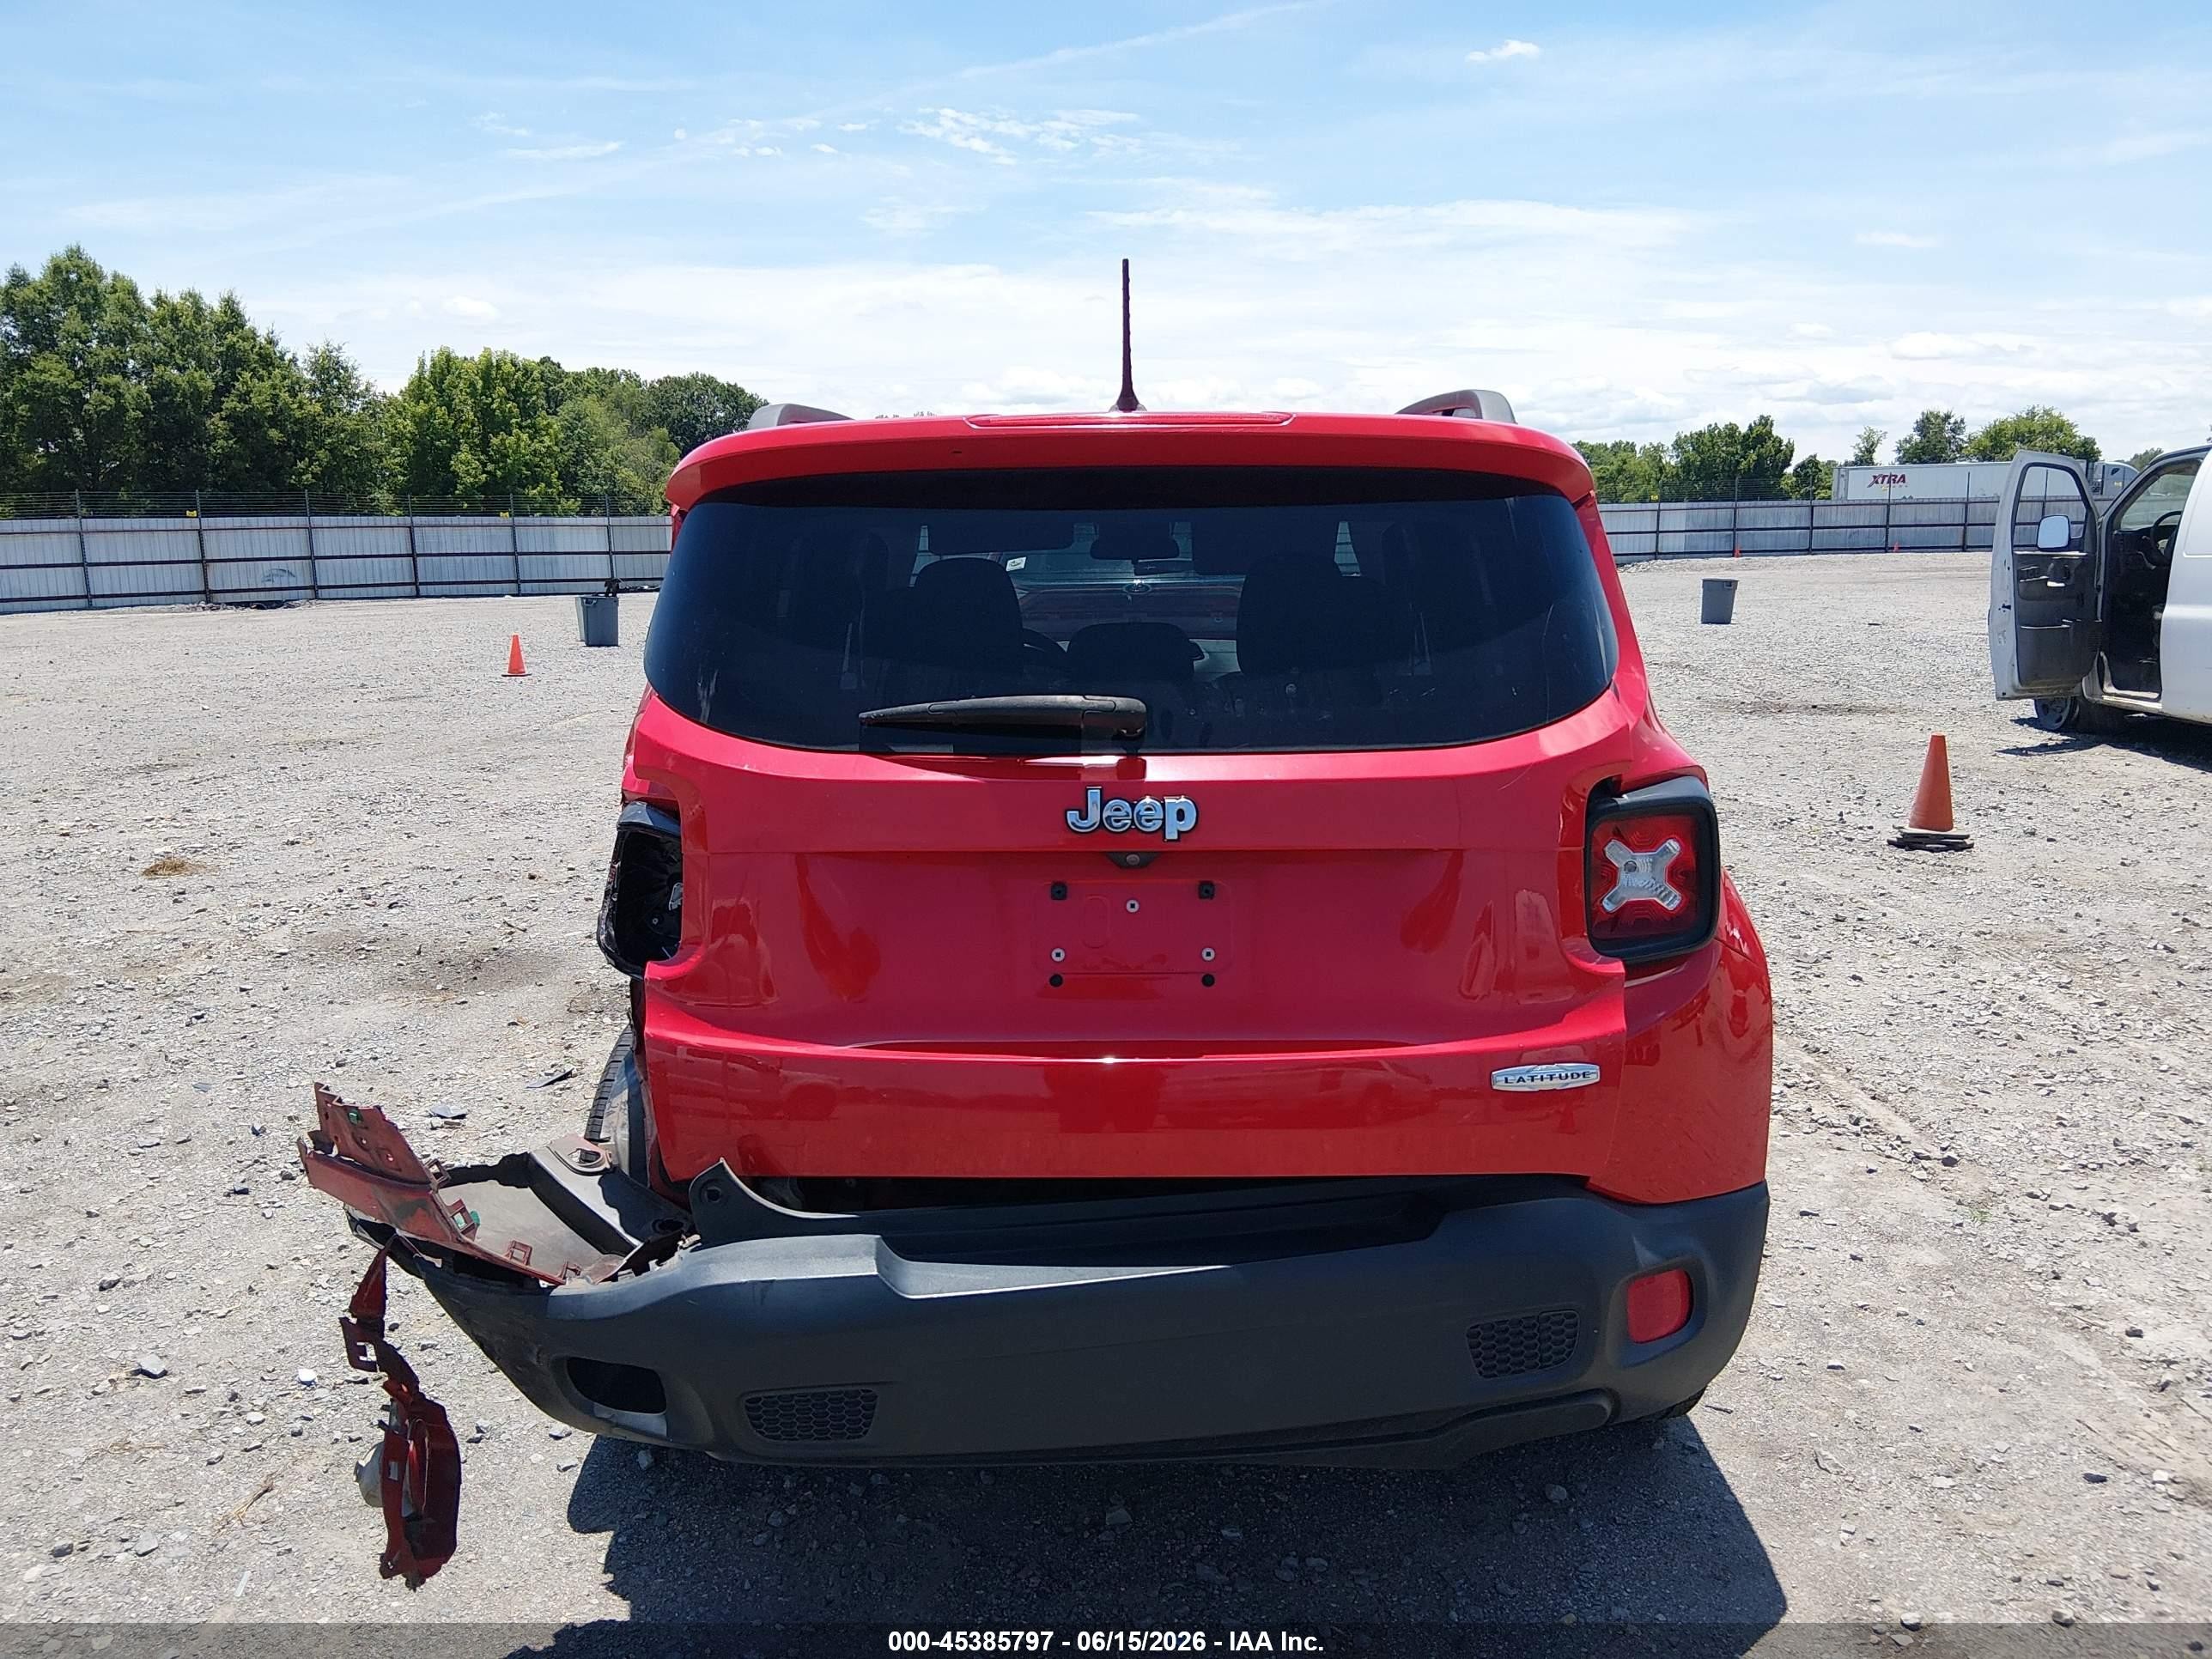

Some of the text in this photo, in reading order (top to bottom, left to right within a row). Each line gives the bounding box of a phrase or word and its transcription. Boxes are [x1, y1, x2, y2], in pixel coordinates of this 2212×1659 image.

[1867, 473, 1906, 488] XTRA
[1066, 787, 1198, 841] Jeep
[1504, 1071, 1591, 1085] LATITUDE
